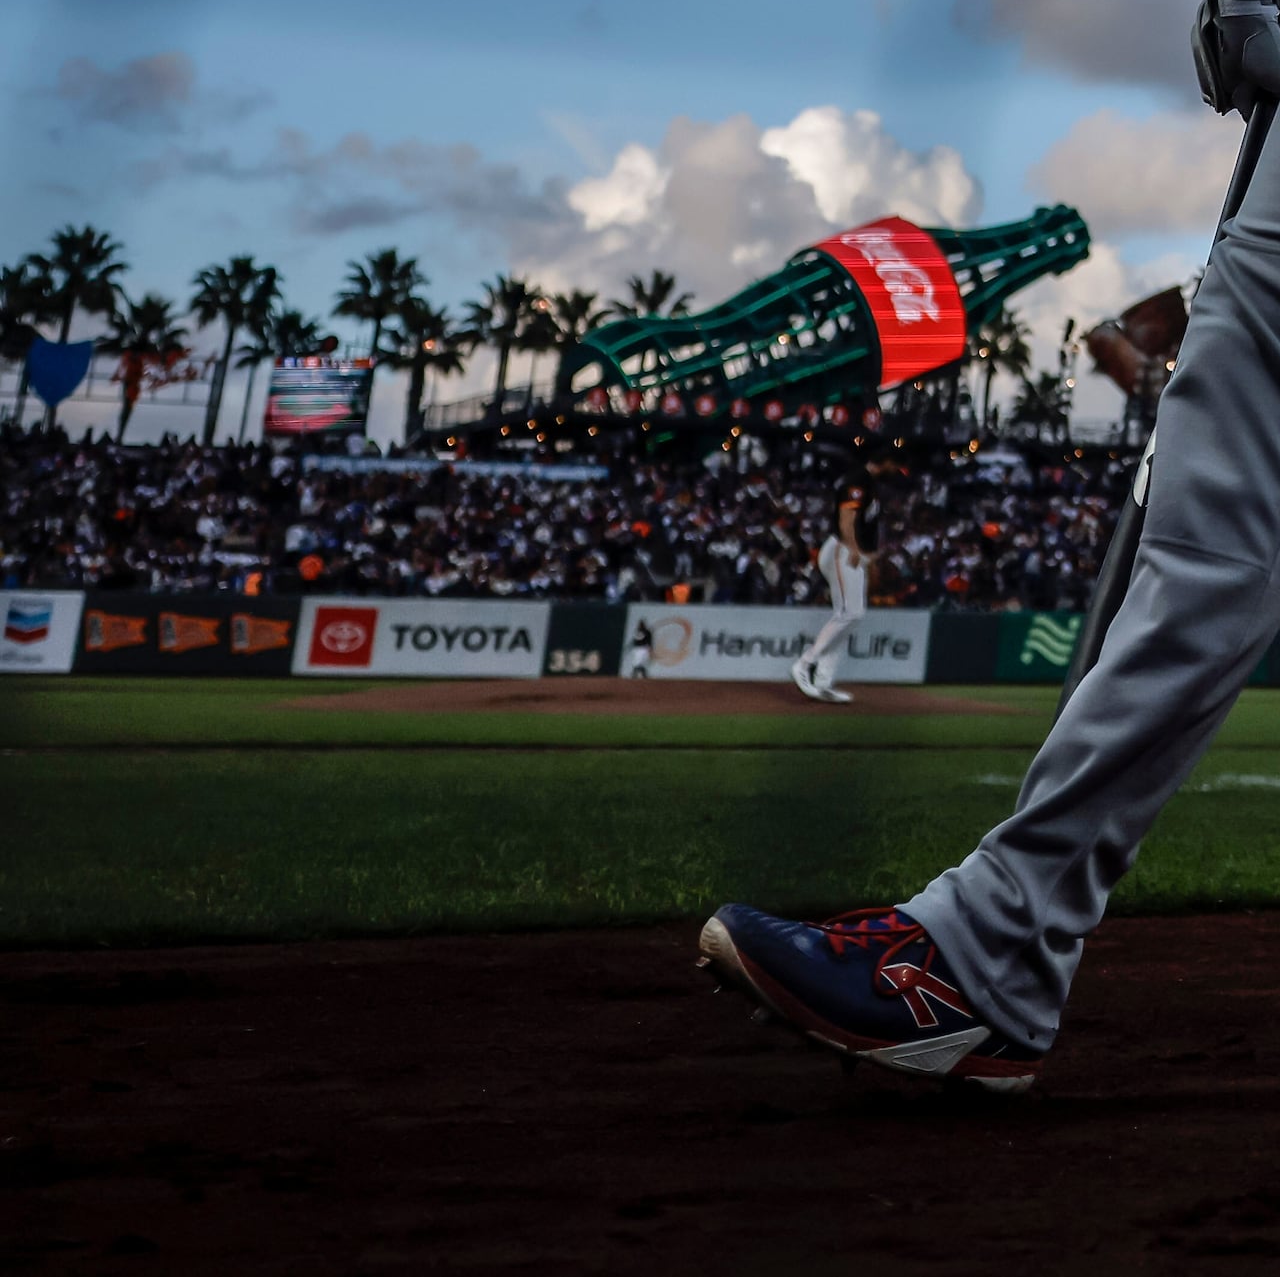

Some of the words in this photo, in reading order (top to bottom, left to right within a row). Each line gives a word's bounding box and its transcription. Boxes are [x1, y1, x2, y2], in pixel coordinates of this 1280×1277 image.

[390, 623, 534, 655] TOYOTA
[847, 633, 912, 661] Life
[549, 649, 602, 674] 354
